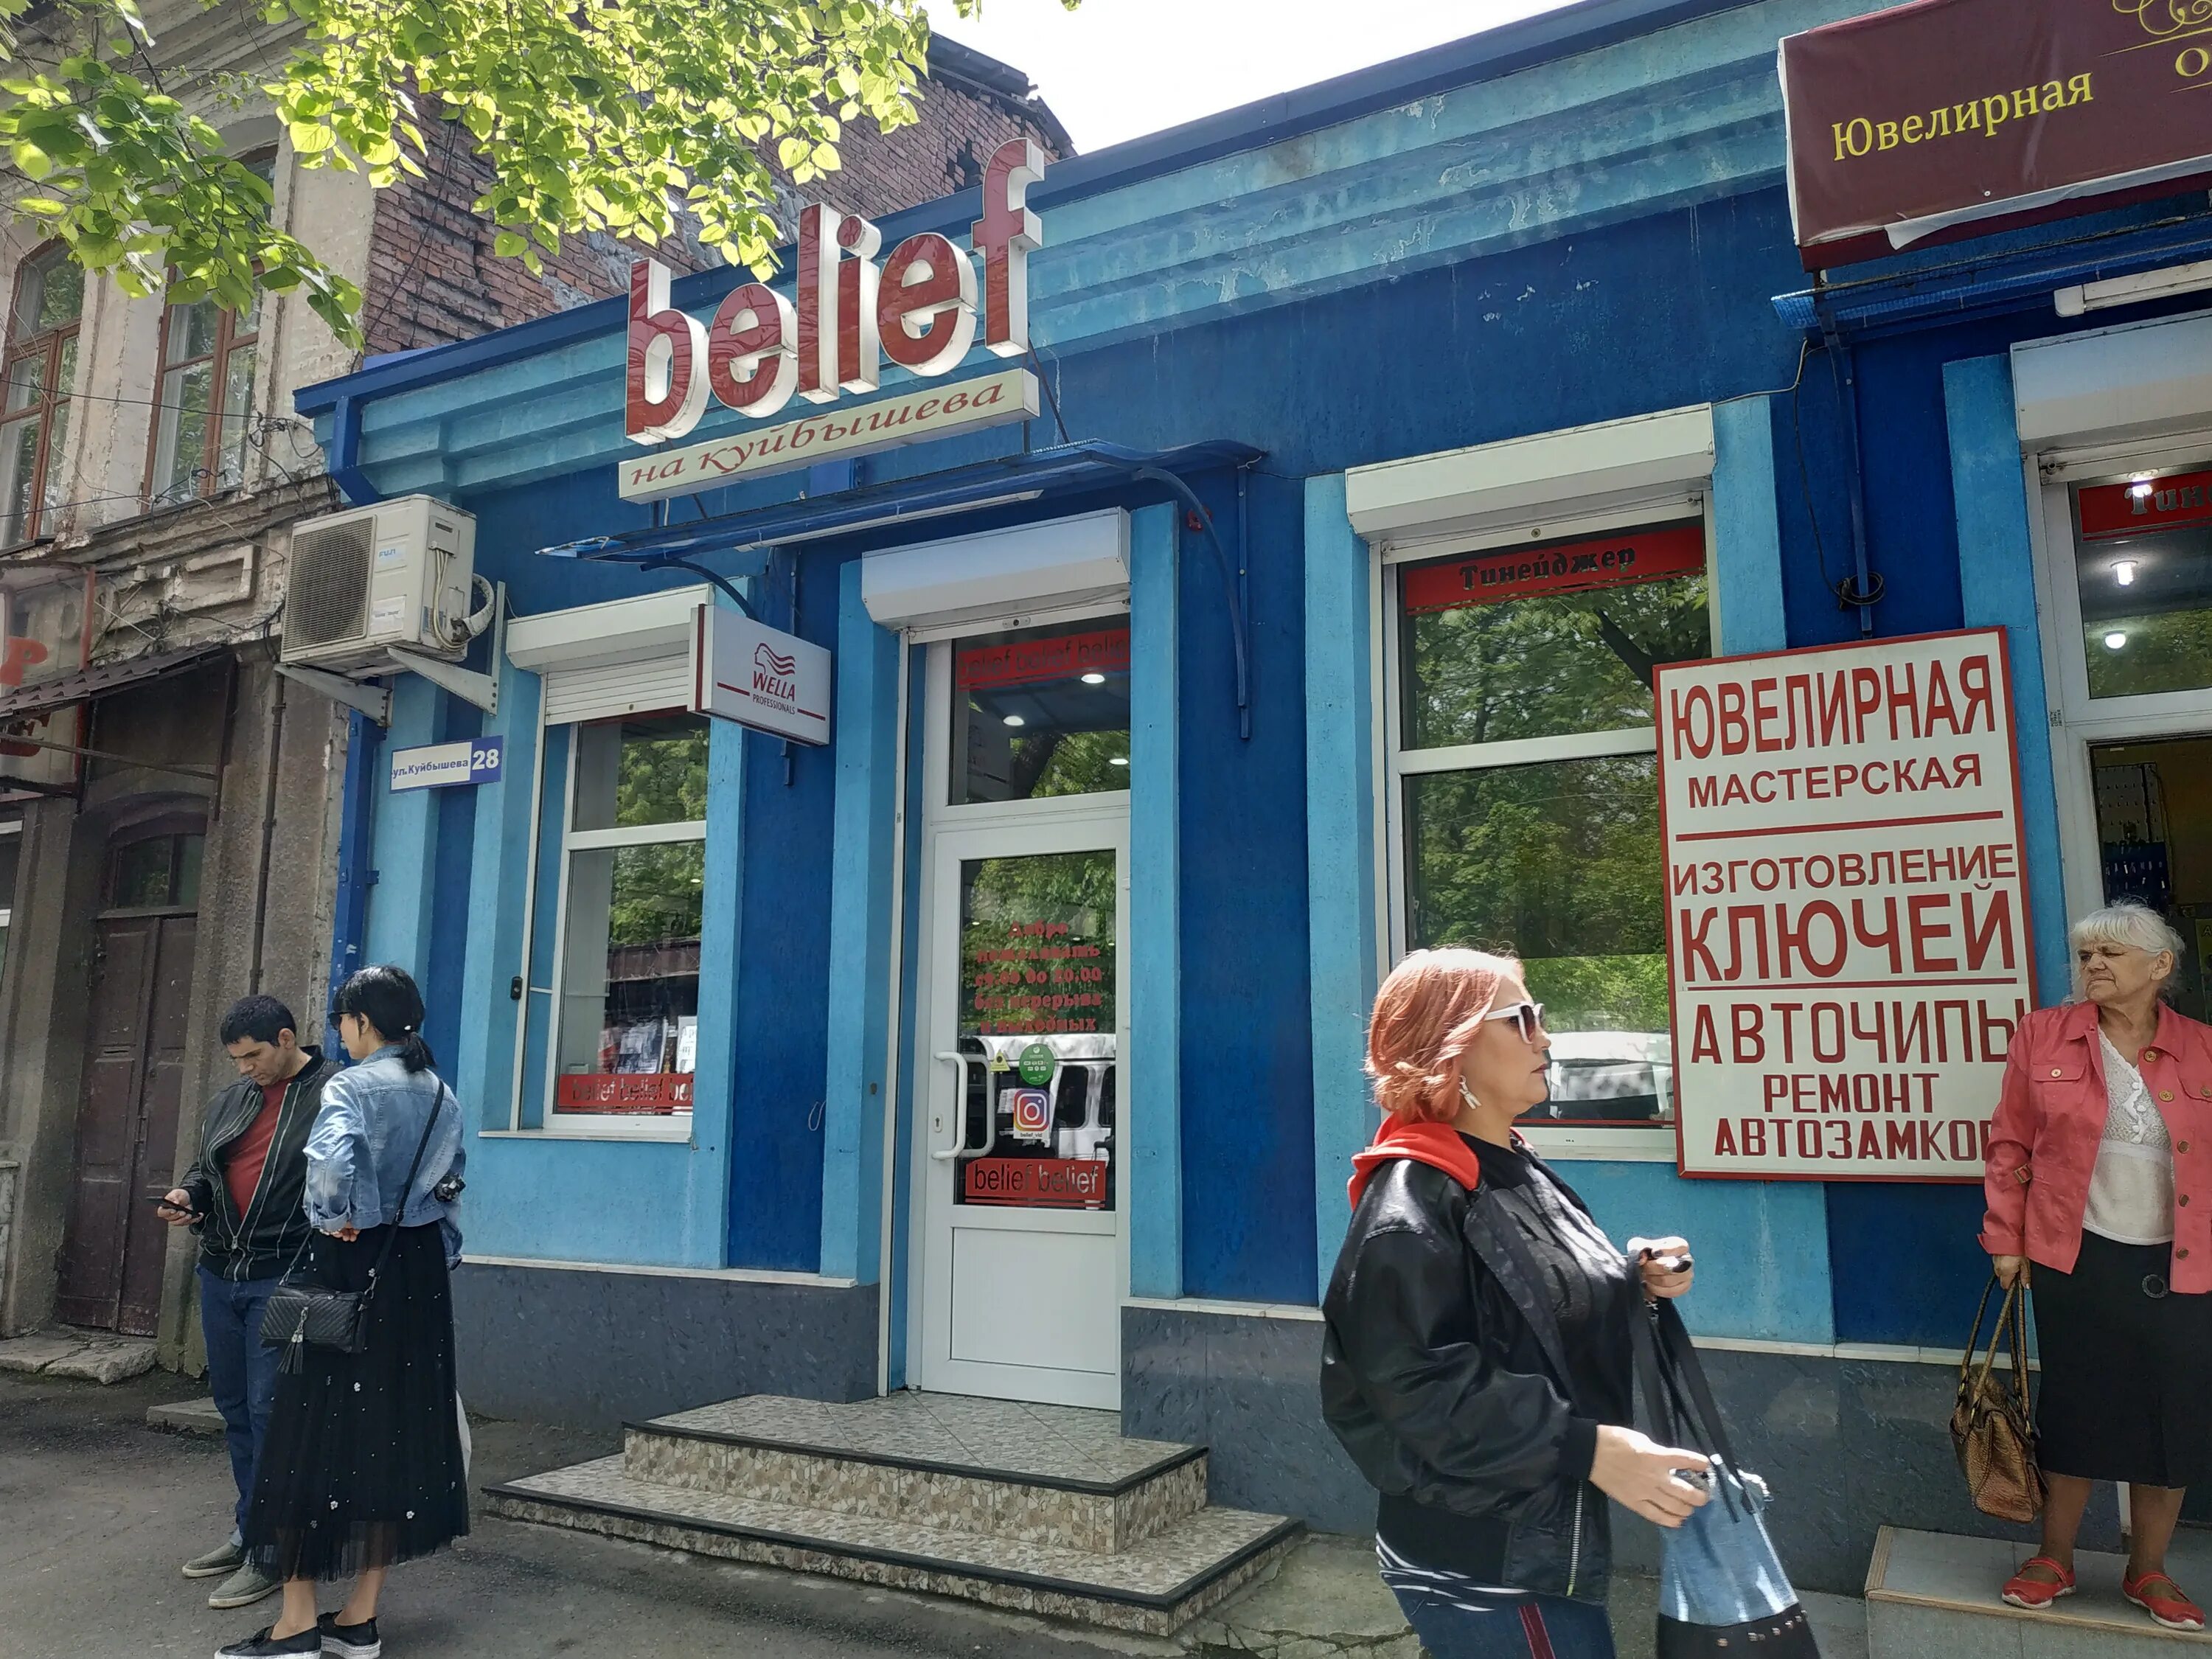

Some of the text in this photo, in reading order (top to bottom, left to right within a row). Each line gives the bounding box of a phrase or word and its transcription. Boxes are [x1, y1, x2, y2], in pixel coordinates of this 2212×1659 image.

[1832, 72, 2094, 161] Ювелирная
[625, 138, 1044, 445] belief
[632, 381, 1005, 486] на куйбышева
[2124, 484, 2212, 515] Тин
[1459, 546, 1636, 590] Тинейджер
[752, 693, 796, 715] PROFESSIONALS
[753, 670, 796, 701] WELLA
[1670, 654, 1996, 761] ЮВЕЛИРНАЯ
[472, 748, 499, 771] 28
[1688, 754, 1983, 808] МАСТЕРСКАЯ
[1672, 844, 2017, 896] ИЗГОТОВЛЕНИЕ
[1680, 882, 2016, 981] КЛЮЧЕЙ
[1691, 998, 2025, 1064] АВТОЧИПЫ
[1763, 1073, 1940, 1113] РЕМОНТ
[974, 1164, 1099, 1194] belief belief
